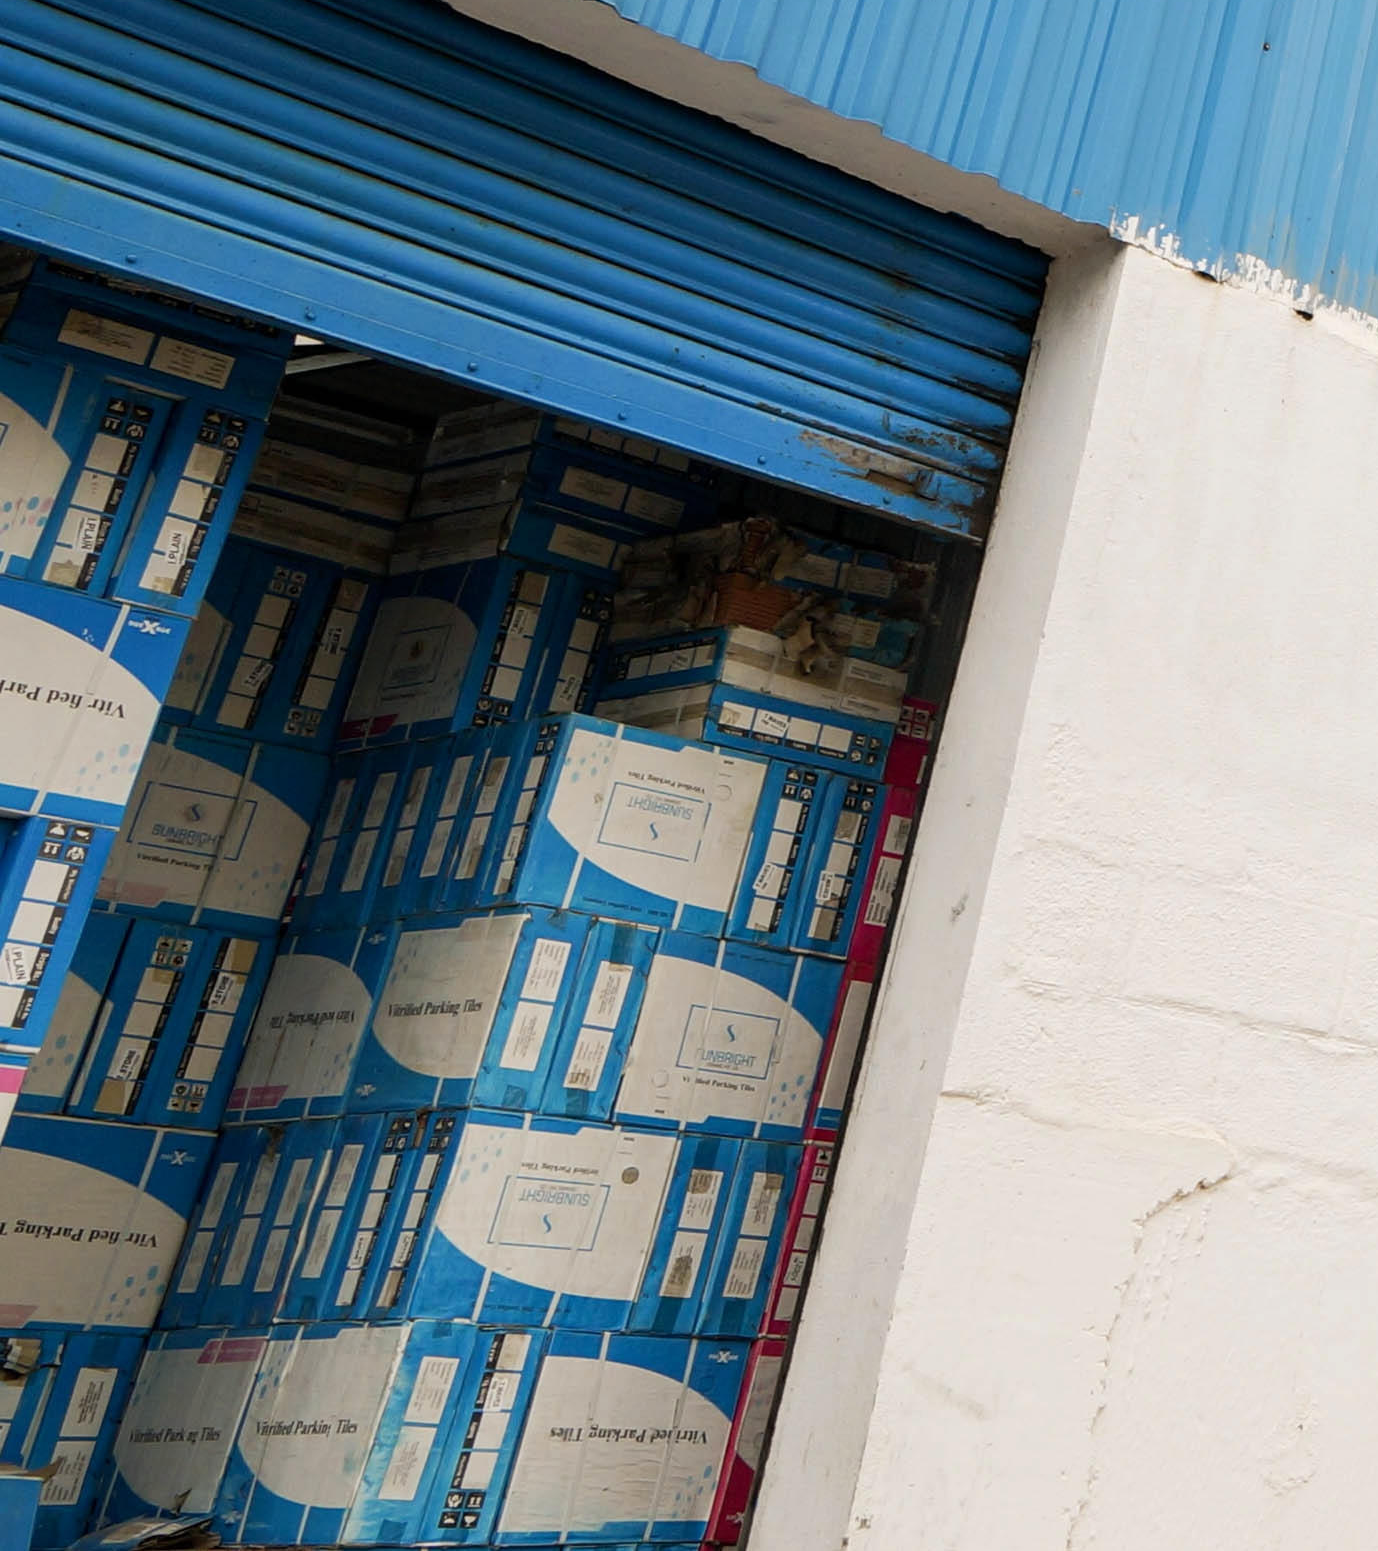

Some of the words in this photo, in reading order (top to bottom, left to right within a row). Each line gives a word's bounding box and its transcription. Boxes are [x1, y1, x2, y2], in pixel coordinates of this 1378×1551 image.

[518, 1187, 591, 1207] SUNBRIGHT
[14, 1219, 84, 1243] Parking
[335, 1418, 358, 1435] Tiles
[548, 1426, 584, 1444] Tiles
[587, 1424, 647, 1444] Parking
